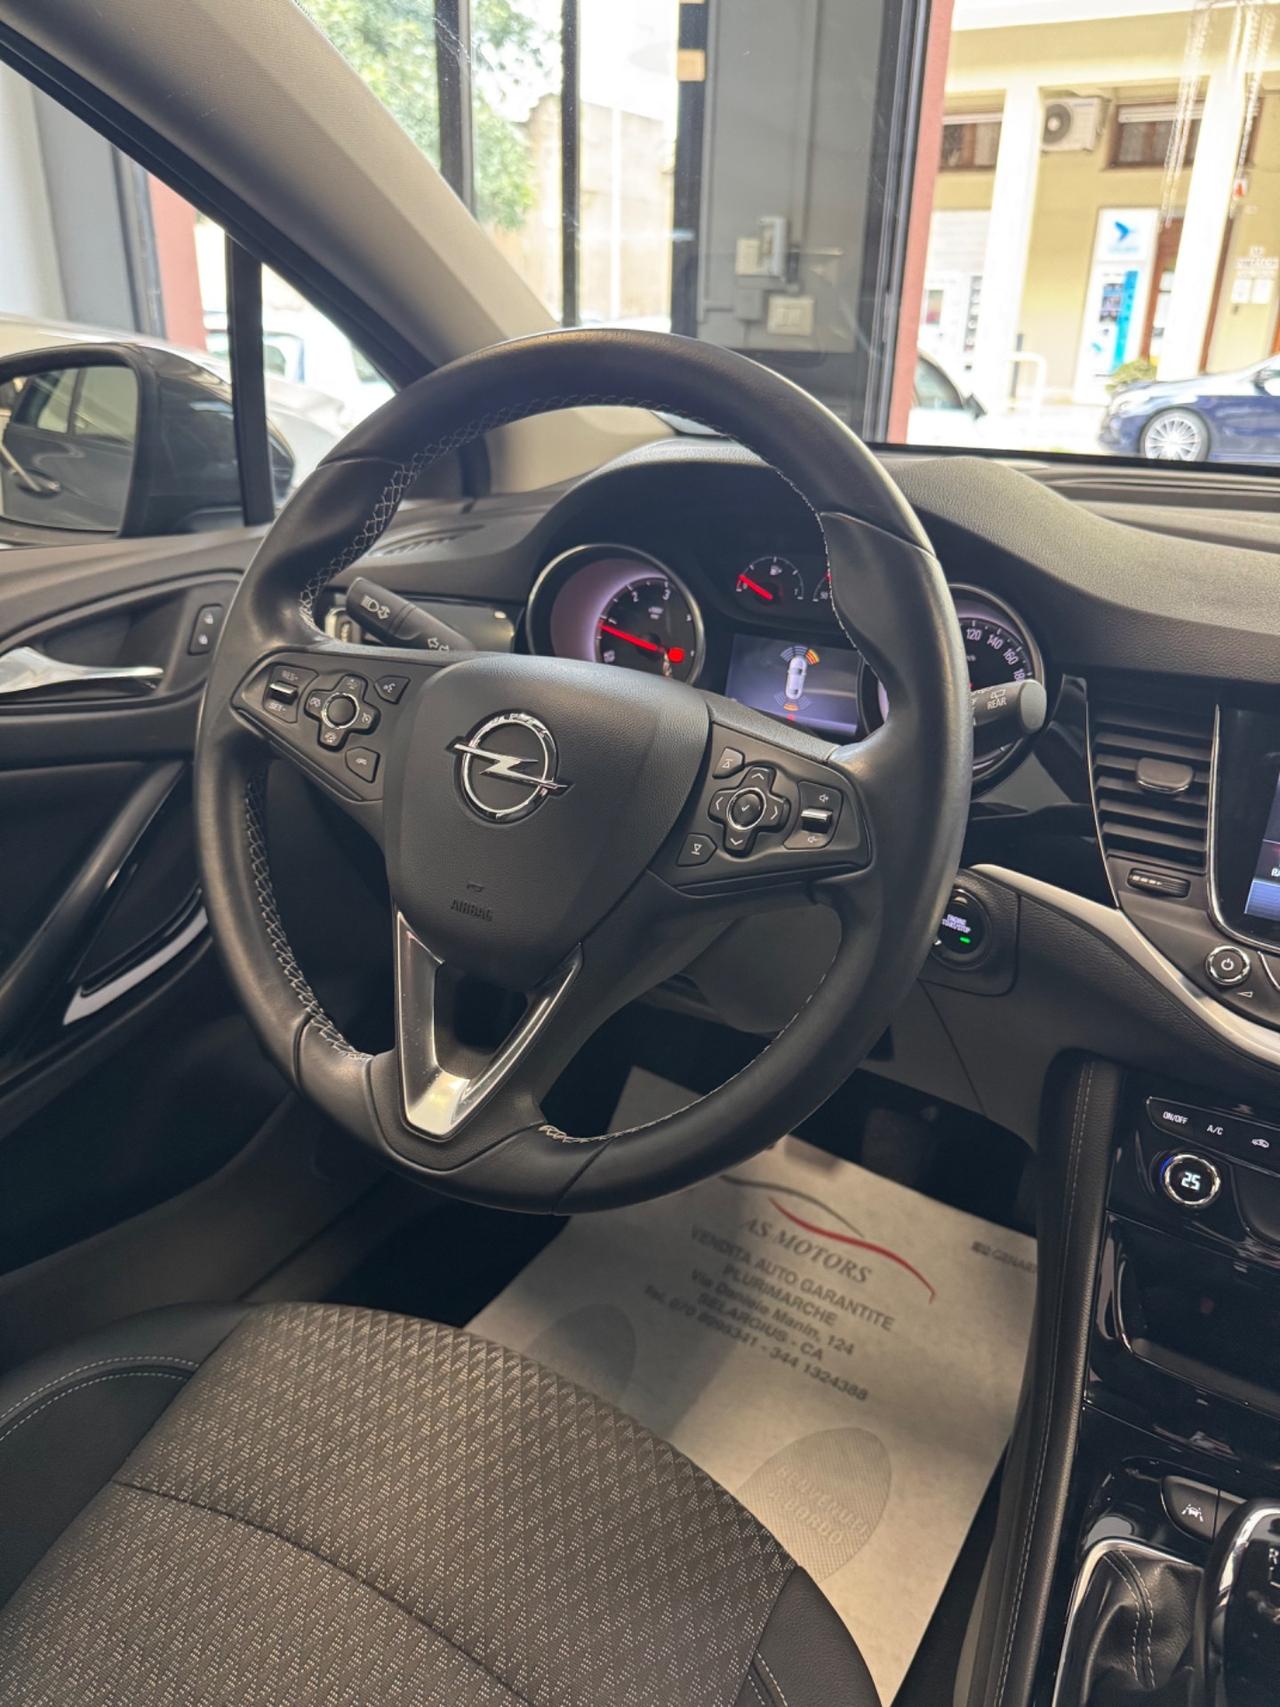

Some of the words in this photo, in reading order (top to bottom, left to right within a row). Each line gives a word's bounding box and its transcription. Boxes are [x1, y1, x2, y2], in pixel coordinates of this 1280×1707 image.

[632, 592, 639, 602] 2
[662, 589, 671, 601] 3
[966, 628, 982, 641] 120
[987, 634, 1004, 650] 140
[1003, 648, 1020, 666] 160
[1013, 668, 1027, 681] 18
[1162, 1111, 1189, 1125] ON/OFF
[1206, 1124, 1224, 1136] A/C
[1181, 1171, 1201, 1191] 25
[774, 1230, 872, 1285] MOTORS
[691, 1225, 751, 1264] VENDITA
[754, 1257, 798, 1286] AUTO
[799, 1278, 896, 1332] GARANTITE
[723, 1263, 838, 1328] PLURIMARCHE
[800, 1341, 823, 1361] CA
[827, 1334, 855, 1356] 124
[769, 1346, 799, 1368] 344
